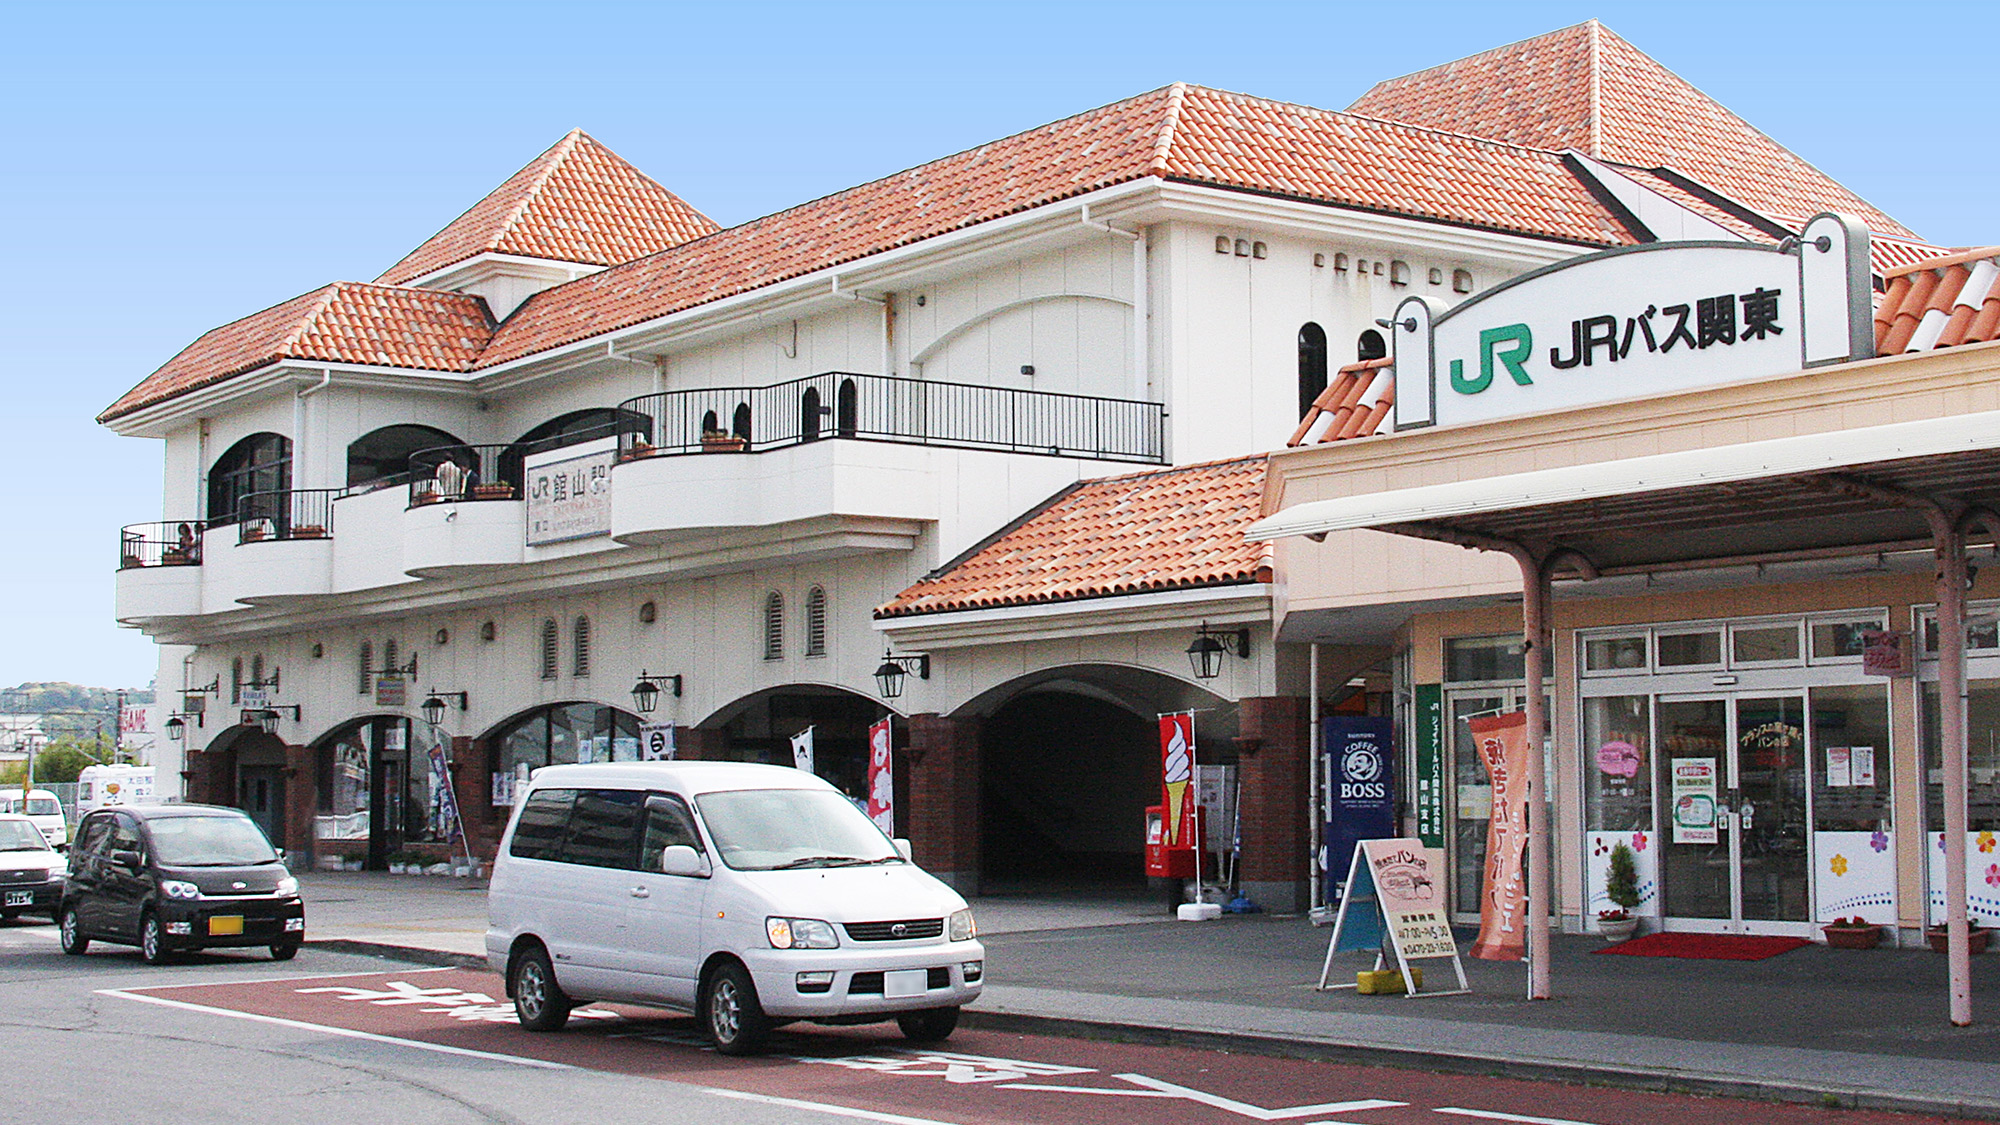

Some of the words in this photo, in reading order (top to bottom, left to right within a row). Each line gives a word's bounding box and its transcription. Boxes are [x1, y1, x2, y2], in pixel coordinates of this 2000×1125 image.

[1550, 287, 1784, 370] JRバス関東
[1450, 323, 1533, 395] JR
[532, 475, 549, 499] JR
[1344, 740, 1380, 755] COFFEE
[1340, 782, 1386, 799] BOSS
